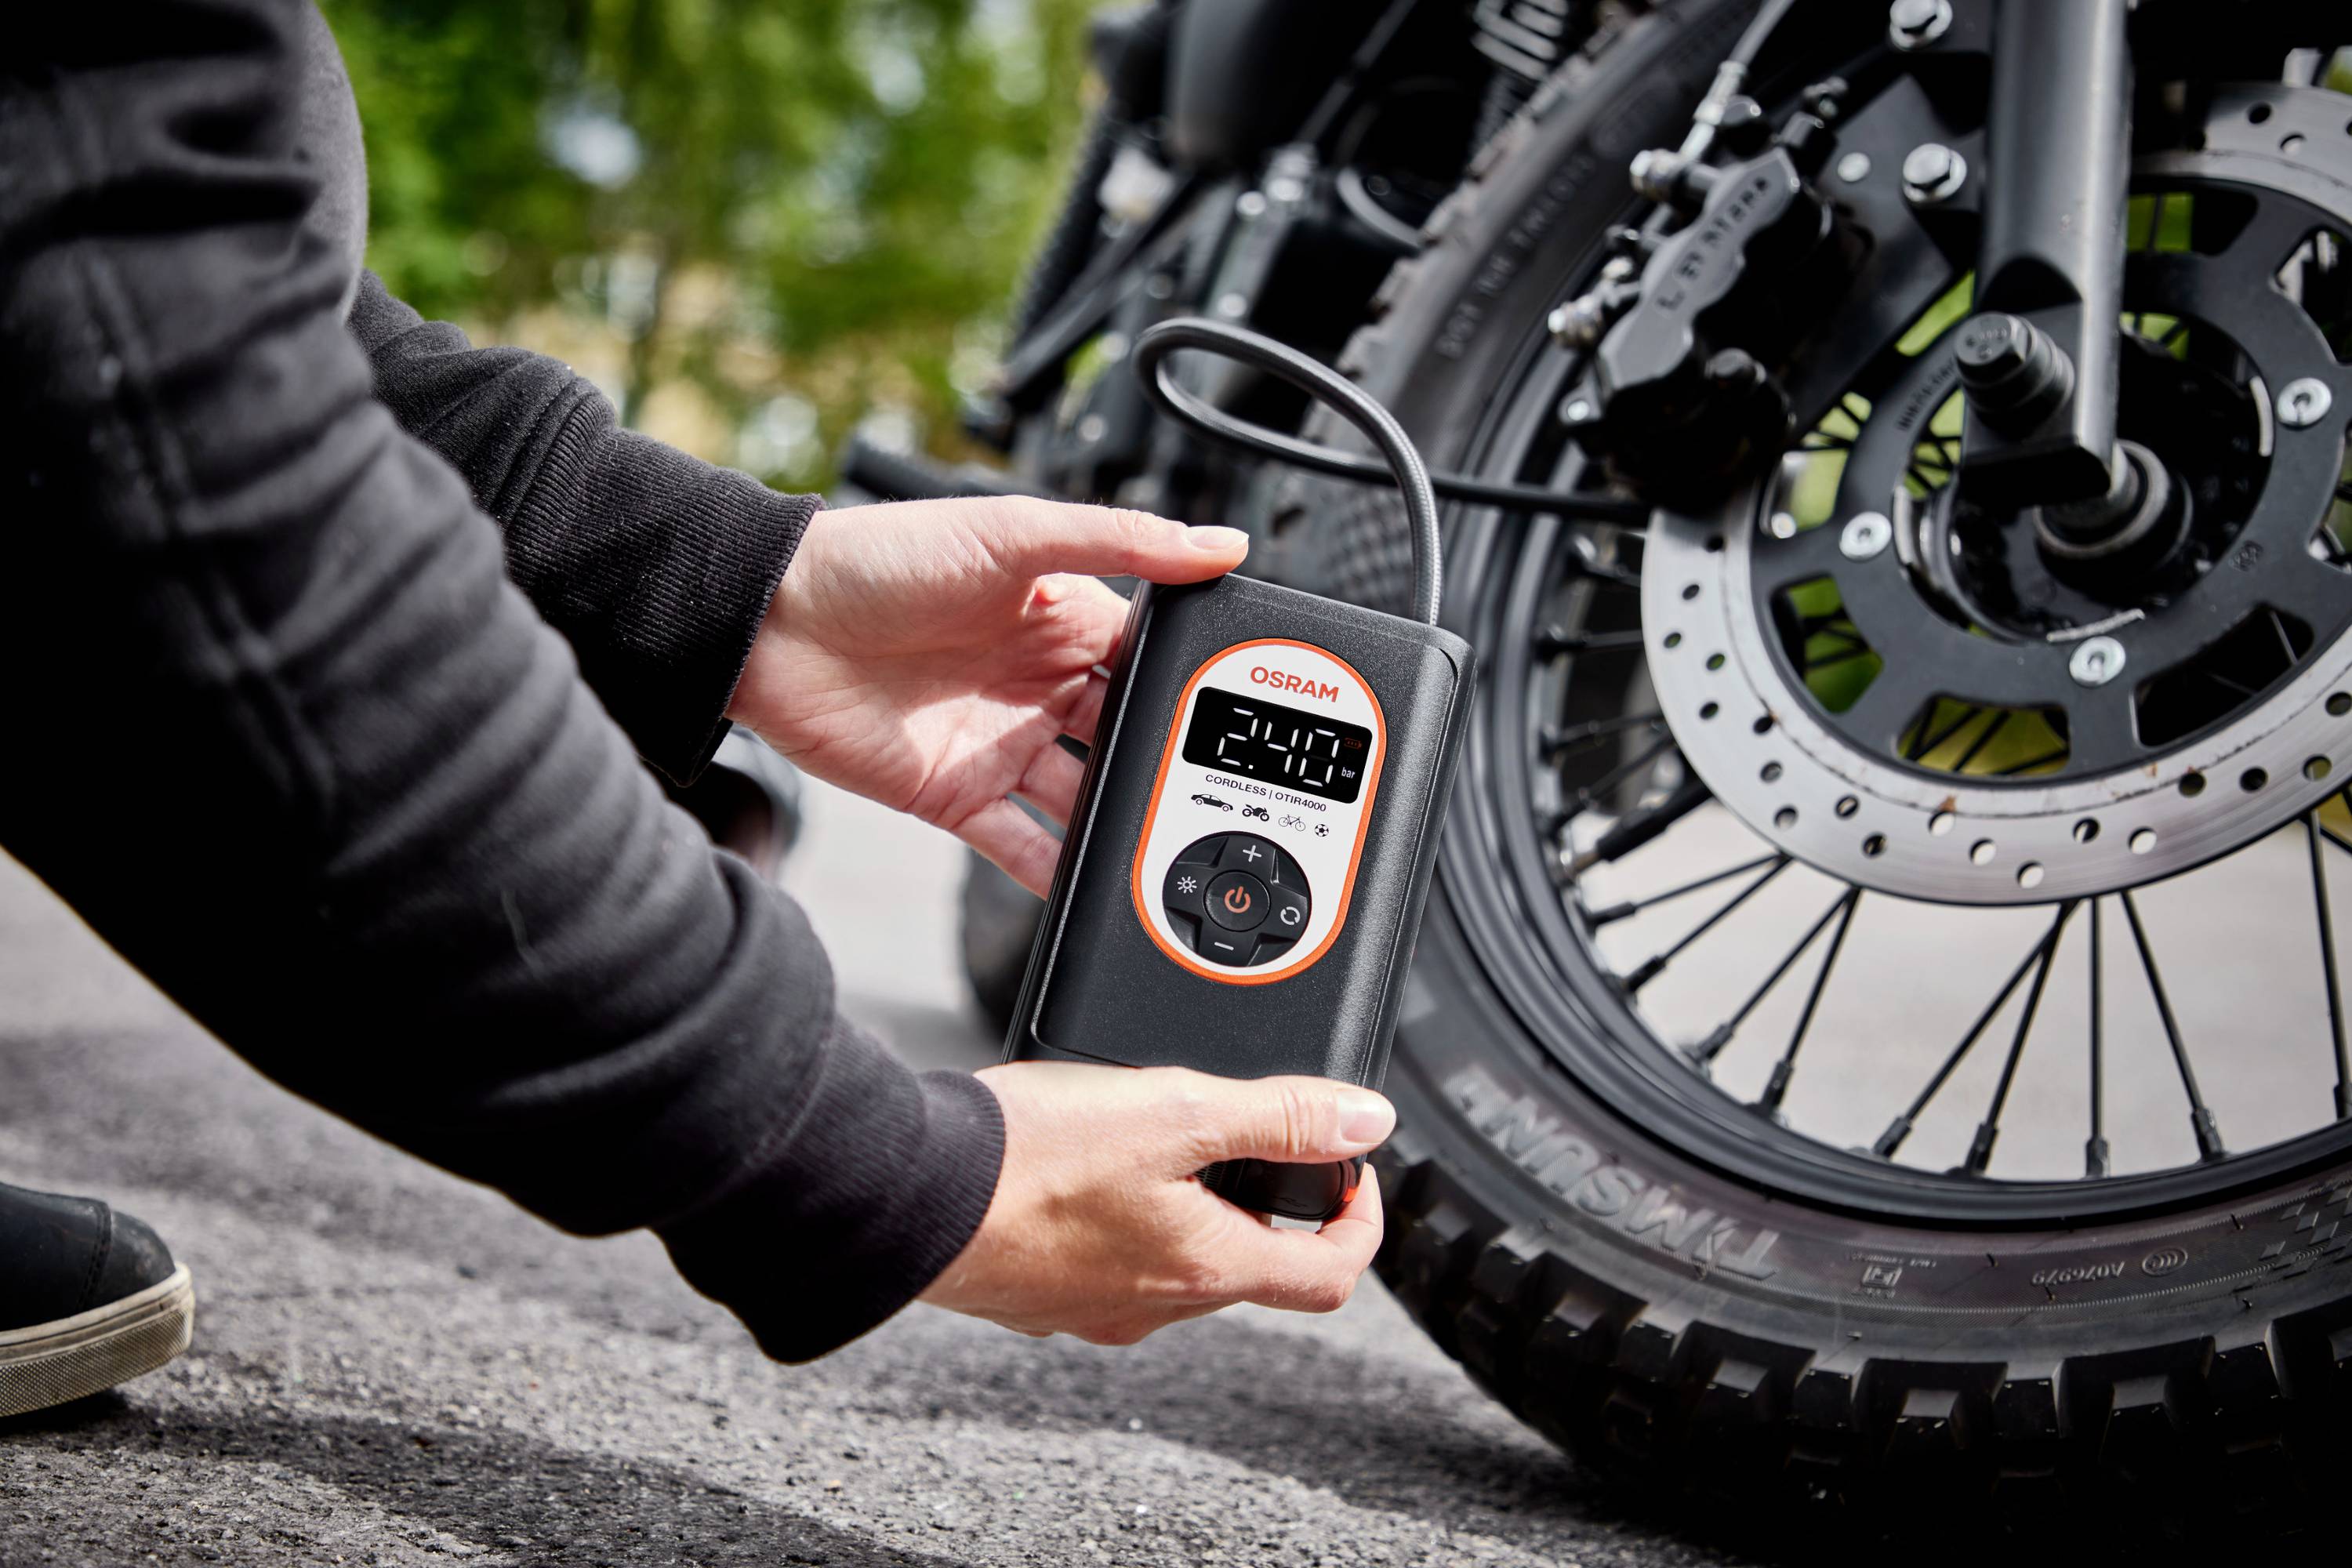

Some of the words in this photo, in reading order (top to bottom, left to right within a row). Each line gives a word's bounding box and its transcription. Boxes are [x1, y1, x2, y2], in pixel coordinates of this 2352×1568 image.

[1250, 666, 1339, 703] OSRAM
[1216, 707, 1340, 788] 2.40
[1341, 766, 1356, 780] bar
[1205, 773, 1267, 797] CORDLESS
[1274, 791, 1327, 813] OTIR4000
